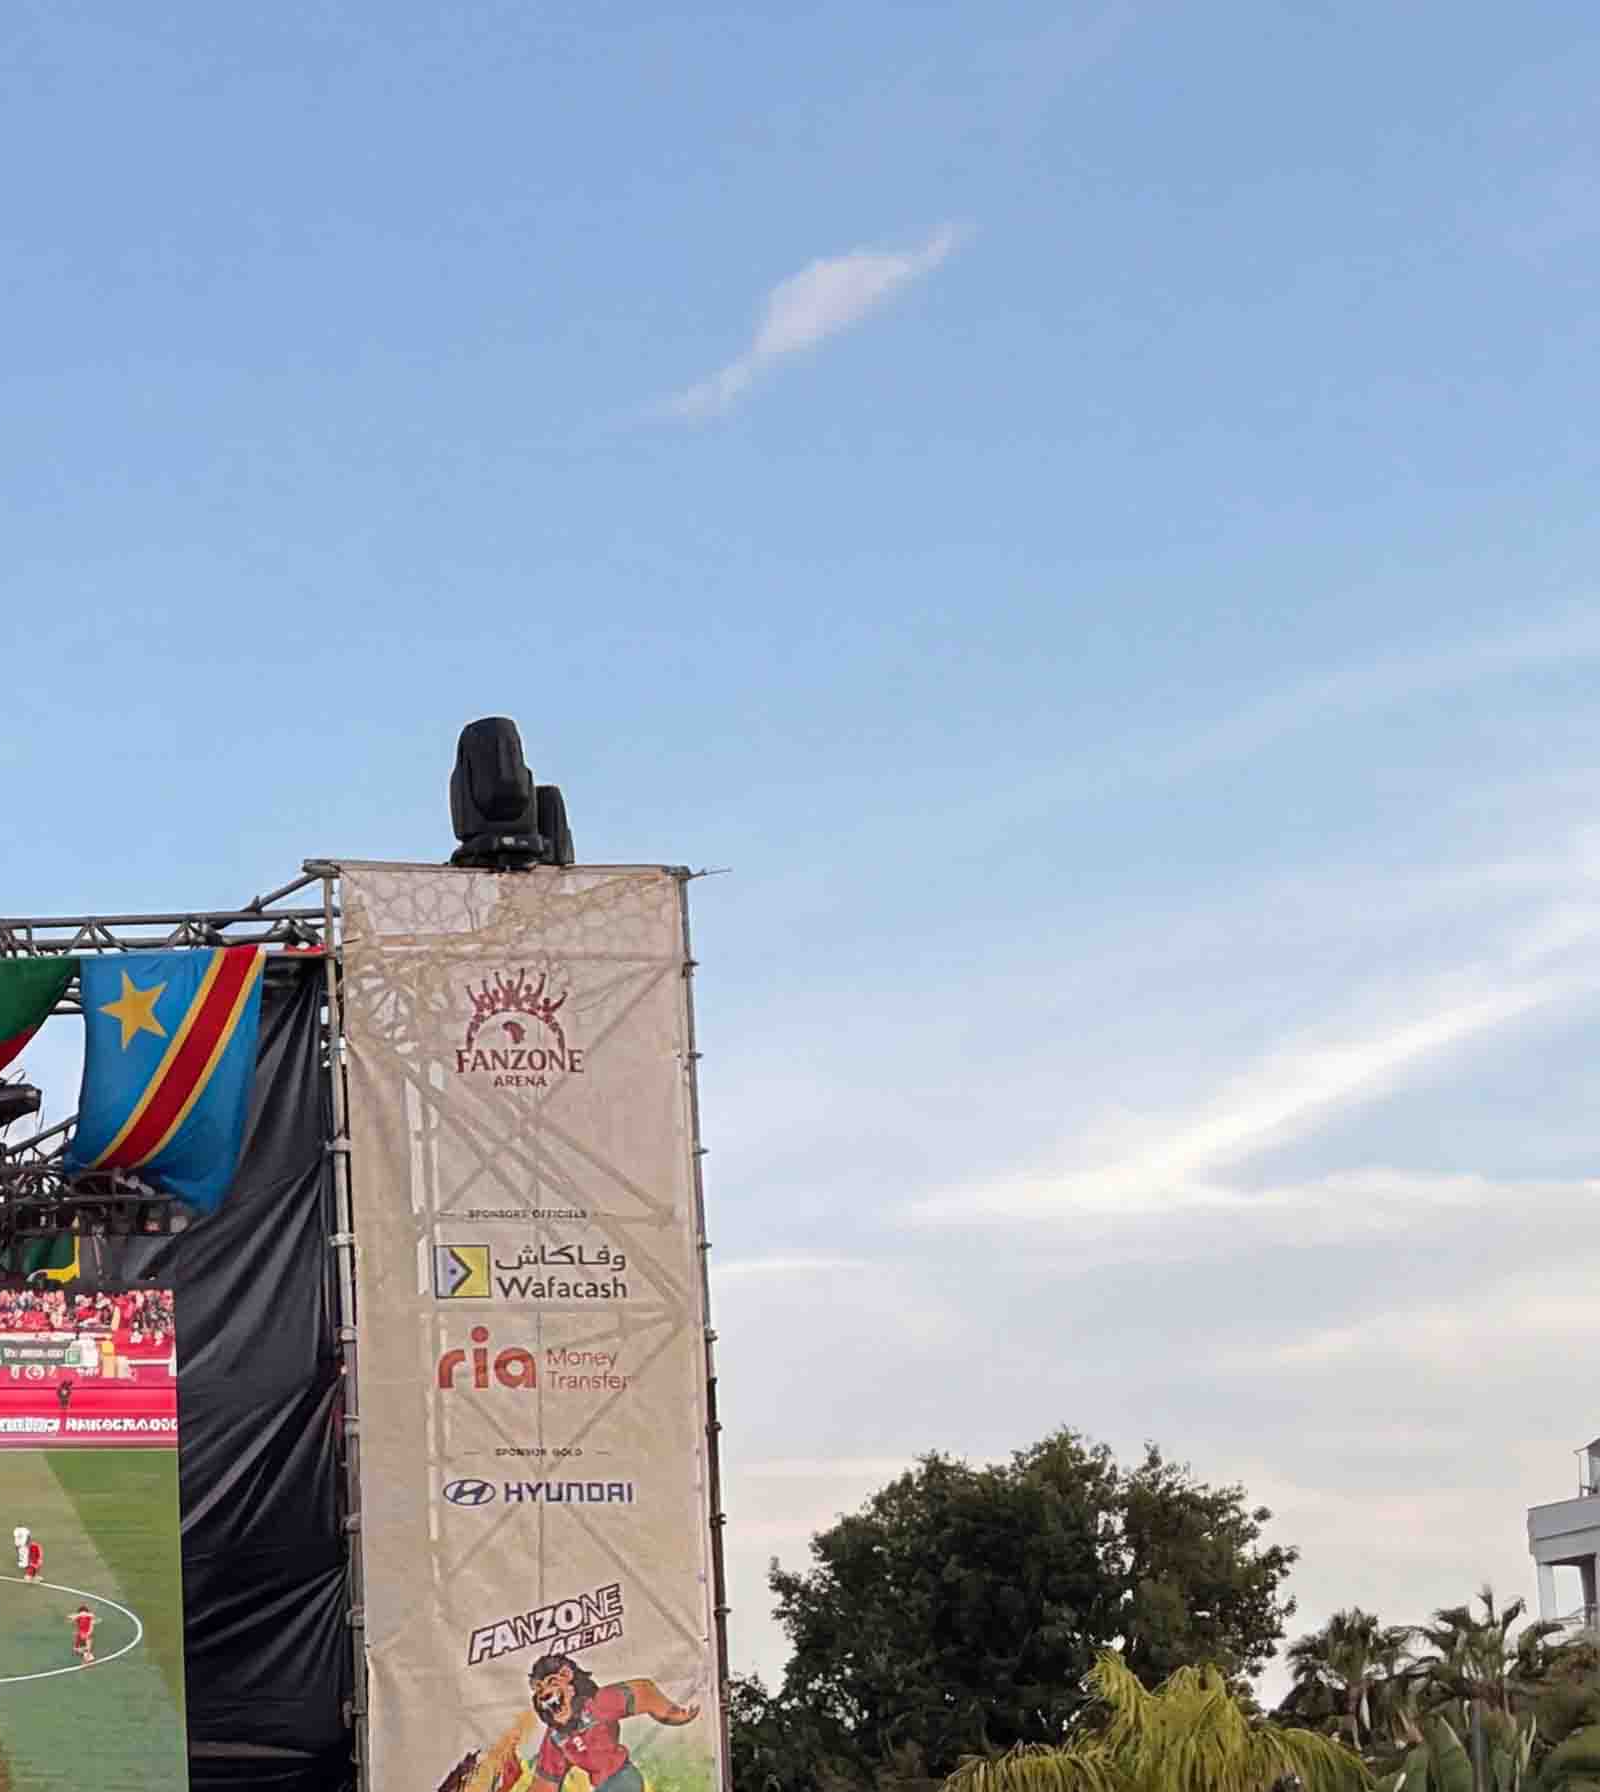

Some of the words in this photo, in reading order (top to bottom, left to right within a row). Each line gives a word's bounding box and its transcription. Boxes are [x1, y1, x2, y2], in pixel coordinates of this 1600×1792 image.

[456, 1049, 584, 1073] FANZONE
[493, 1074, 548, 1088] ARENA
[495, 1245, 626, 1273] وفاكاش
[496, 1276, 627, 1299] Wafacash
[438, 1326, 537, 1389] ria
[546, 1348, 618, 1369] Money
[546, 1371, 632, 1390] Transfer
[504, 1482, 633, 1502] HYUNDAI
[468, 1583, 624, 1665] FANZONE
[550, 1618, 624, 1657] ARENA
